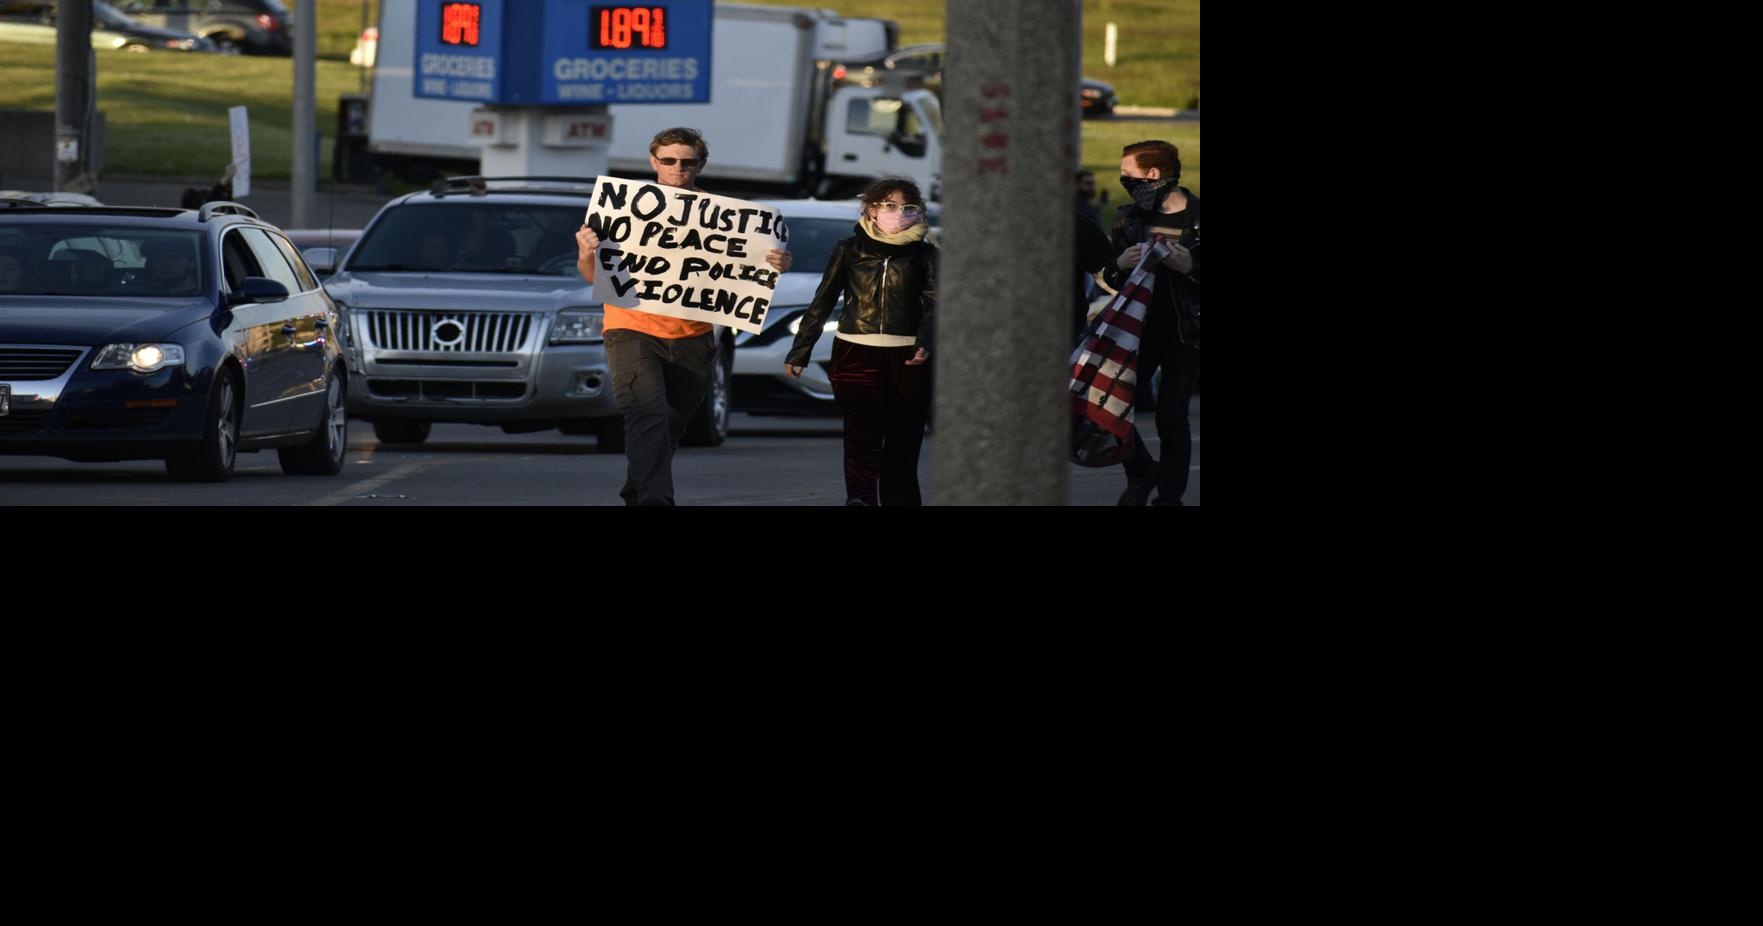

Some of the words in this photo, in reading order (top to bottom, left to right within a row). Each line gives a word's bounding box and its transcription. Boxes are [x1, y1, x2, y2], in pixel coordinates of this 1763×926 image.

[554, 57, 698, 80] GROCERIES
[557, 83, 603, 98] WINE
[617, 83, 694, 99] LIQUORS
[567, 122, 606, 137] ATM
[598, 182, 666, 221] NO
[588, 212, 631, 242] NO
[639, 221, 747, 257] PEACE
[600, 248, 670, 275] END
[679, 257, 779, 289] POLICE
[610, 274, 769, 325] VIOLENCE
